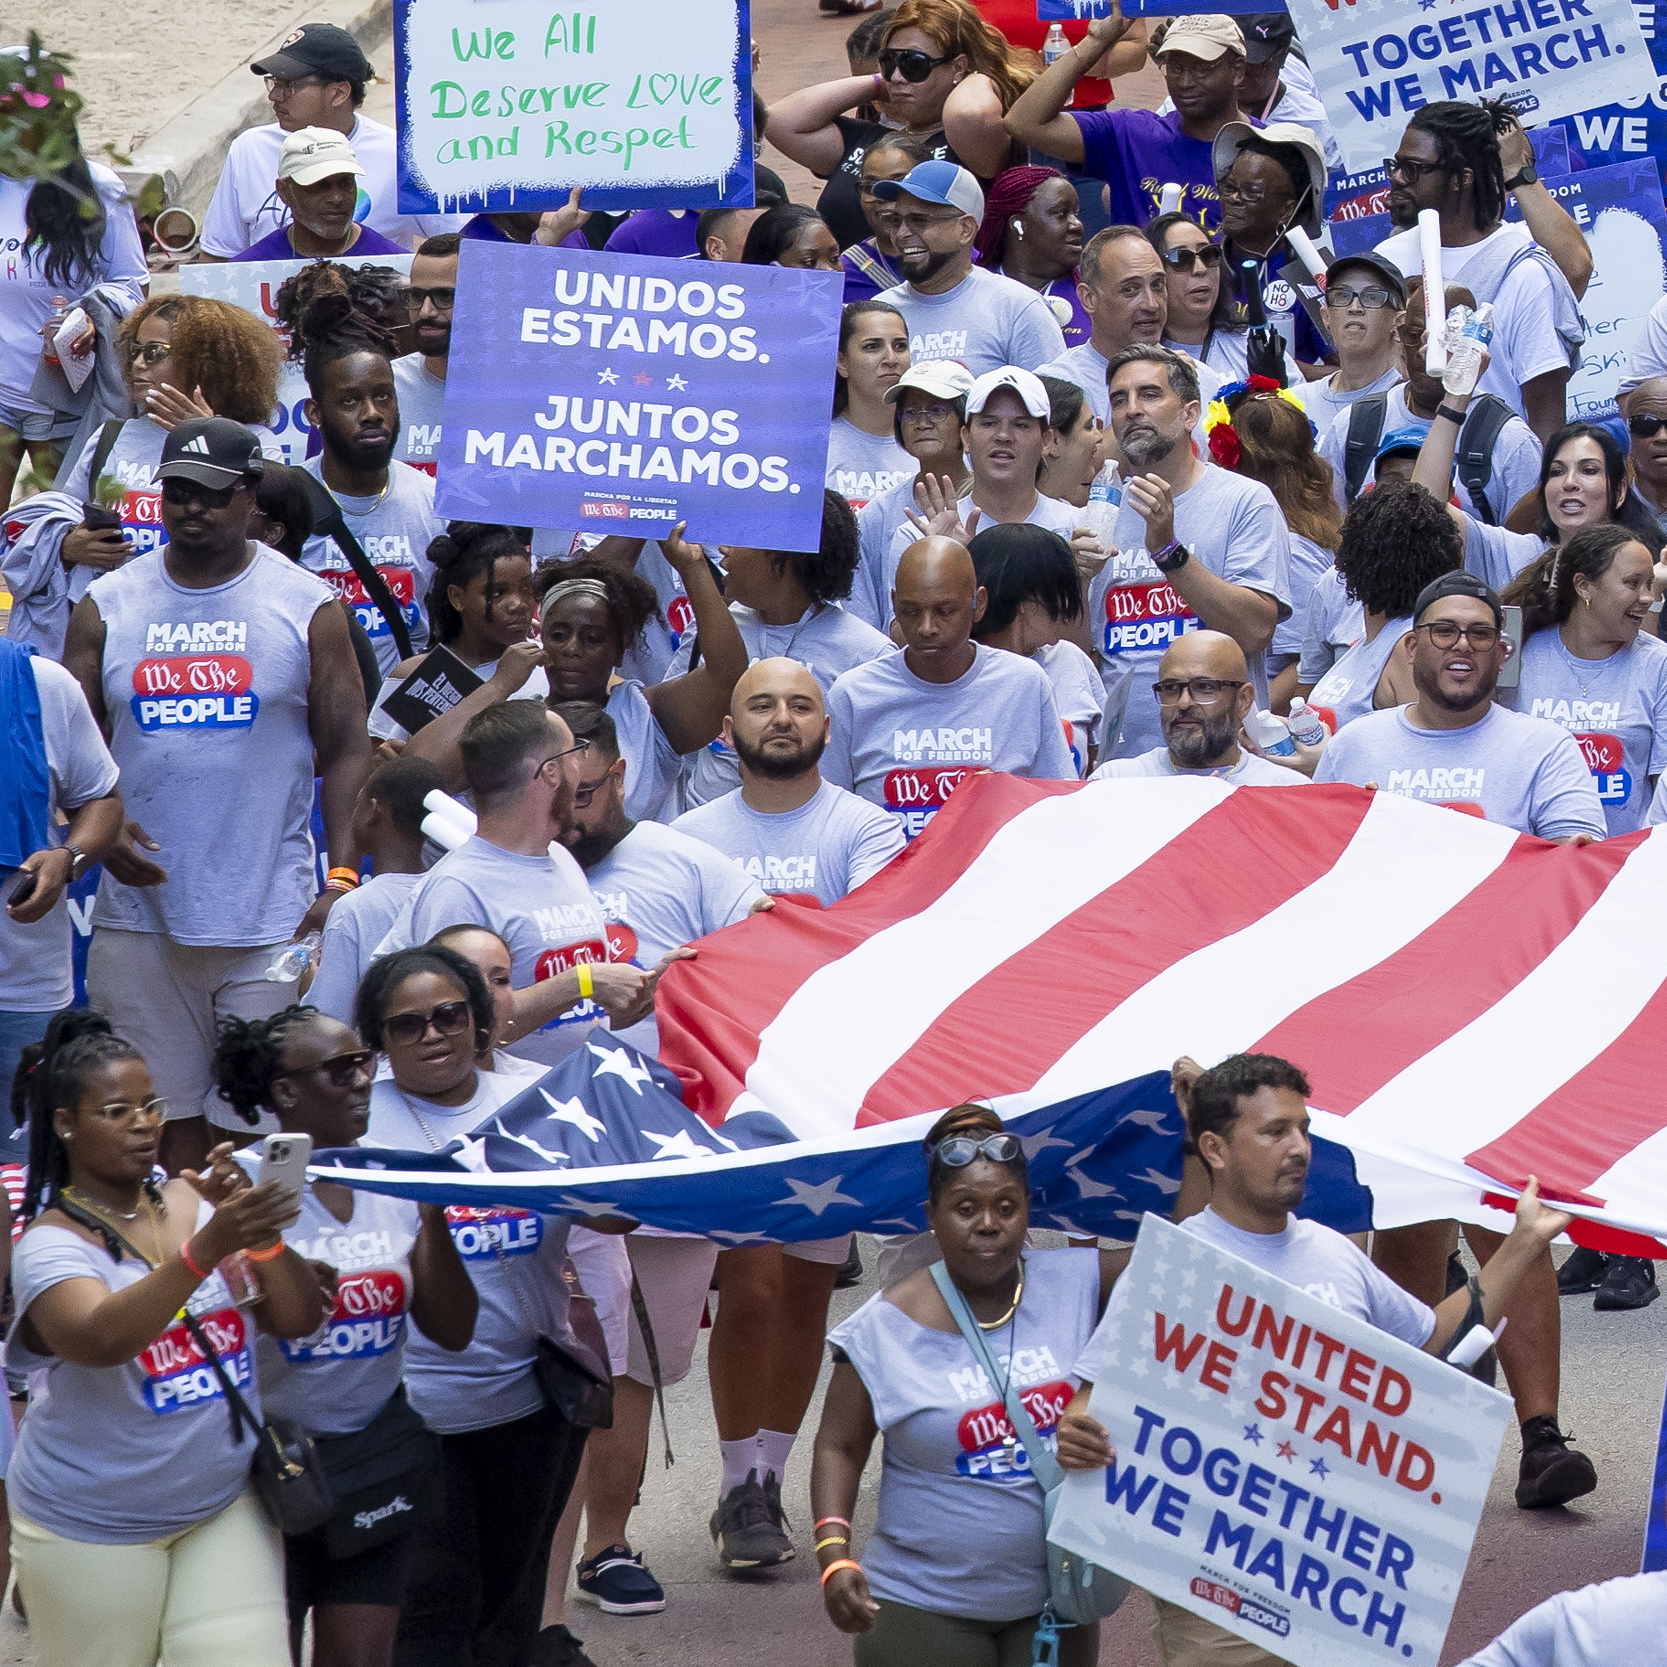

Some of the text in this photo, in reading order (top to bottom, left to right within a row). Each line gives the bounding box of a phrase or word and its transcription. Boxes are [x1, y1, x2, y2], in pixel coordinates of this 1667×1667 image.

[451, 12, 597, 62] We All
[430, 80, 610, 119] Deserve
[436, 116, 698, 171] and Respet
[555, 269, 746, 319] UNIDOS
[520, 308, 770, 364] ESTAMOS.
[534, 395, 739, 446] JUNTOS
[464, 429, 801, 494] MARCHAMOS.
[1216, 1283, 1412, 1418] UNITED
[1152, 1311, 1444, 1507] WE STAND.
[1132, 1403, 1416, 1592] TOGETHER
[1103, 1461, 1415, 1658] WE MARCH.
